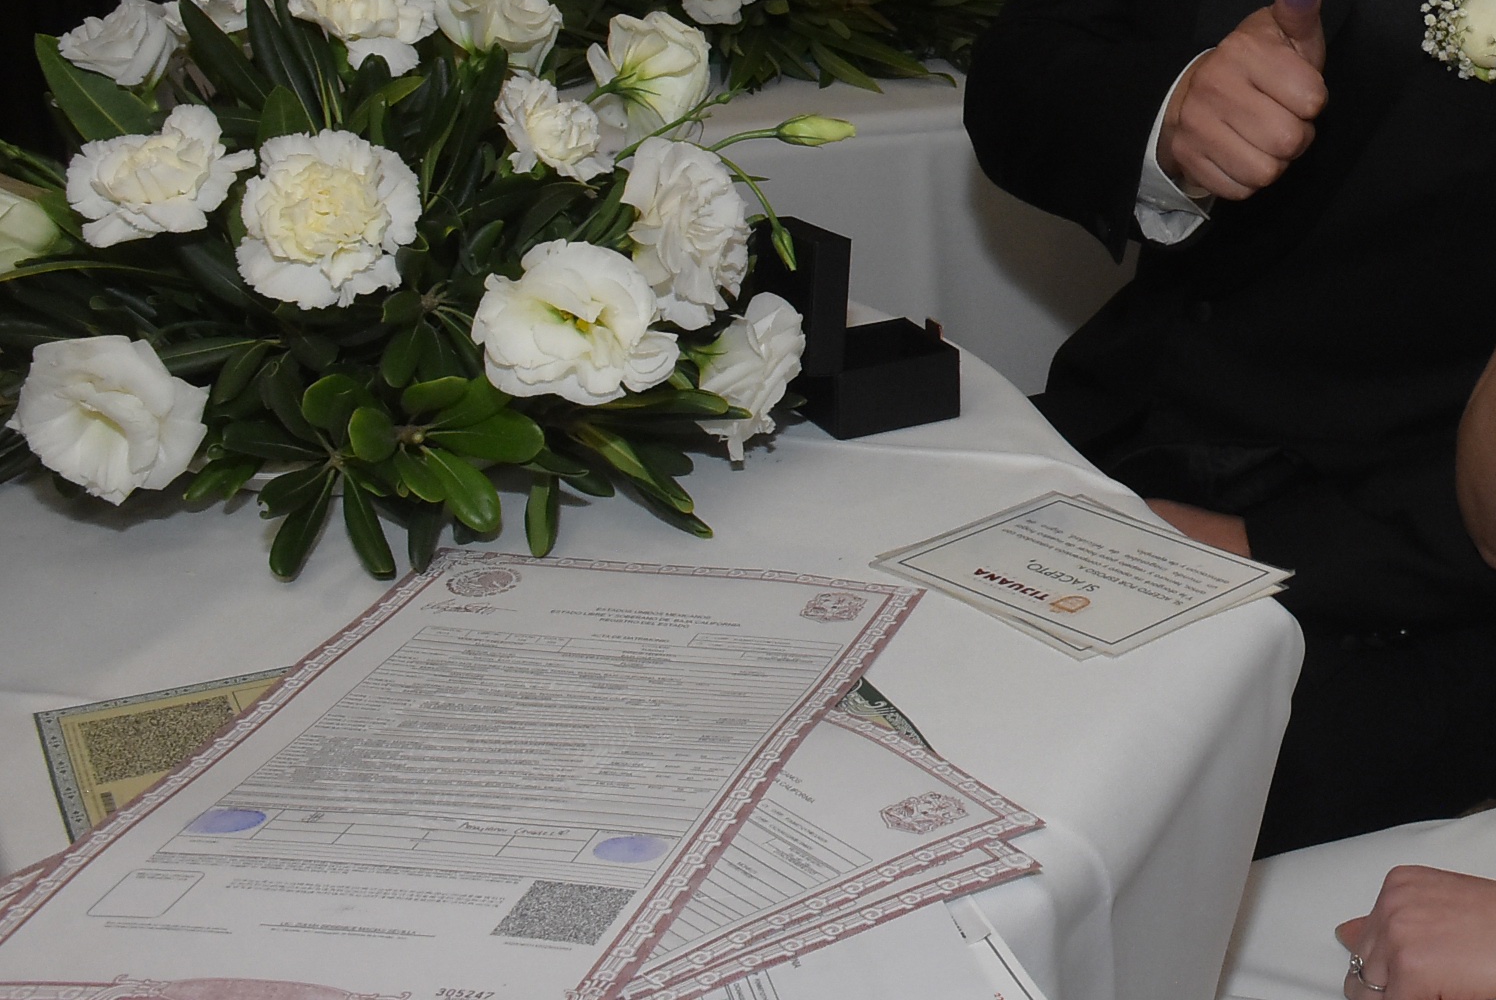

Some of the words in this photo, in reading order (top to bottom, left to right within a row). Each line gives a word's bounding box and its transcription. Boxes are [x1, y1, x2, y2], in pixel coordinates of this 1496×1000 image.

[1027, 559, 1085, 586] ACEPTO,
[1084, 568, 1118, 581] ESPOSO
[974, 567, 1050, 601] TIJUANA
[1118, 580, 1137, 588] POR
[1137, 587, 1170, 600] ACEPTO
[435, 987, 496, 1000] 305247
